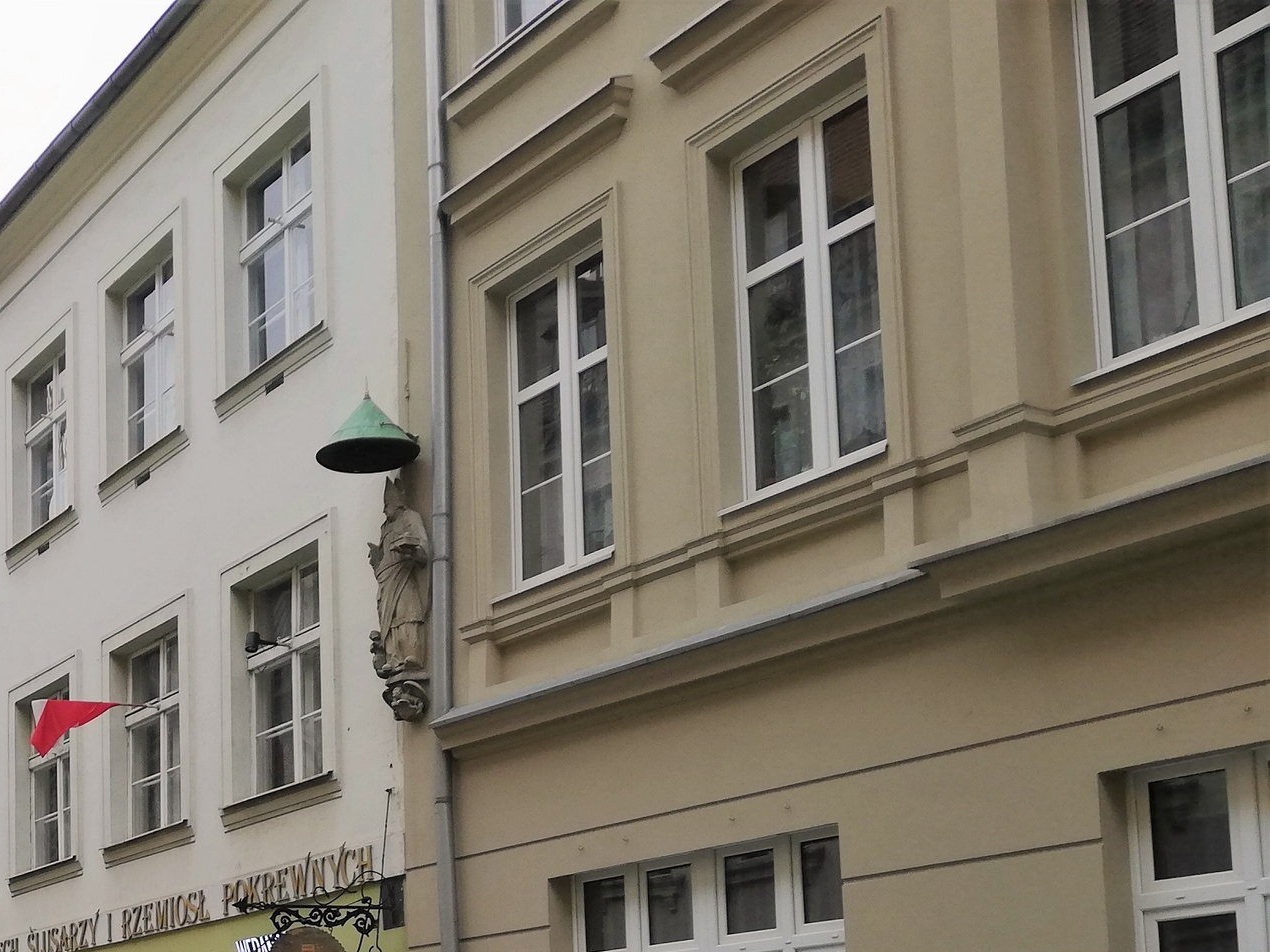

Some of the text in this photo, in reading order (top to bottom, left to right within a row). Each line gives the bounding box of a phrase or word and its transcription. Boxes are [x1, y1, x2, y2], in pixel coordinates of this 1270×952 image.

[106, 912, 113, 943] I
[121, 890, 210, 938] RZEMIOSŁ
[221, 841, 375, 916] POKREWNYCH
